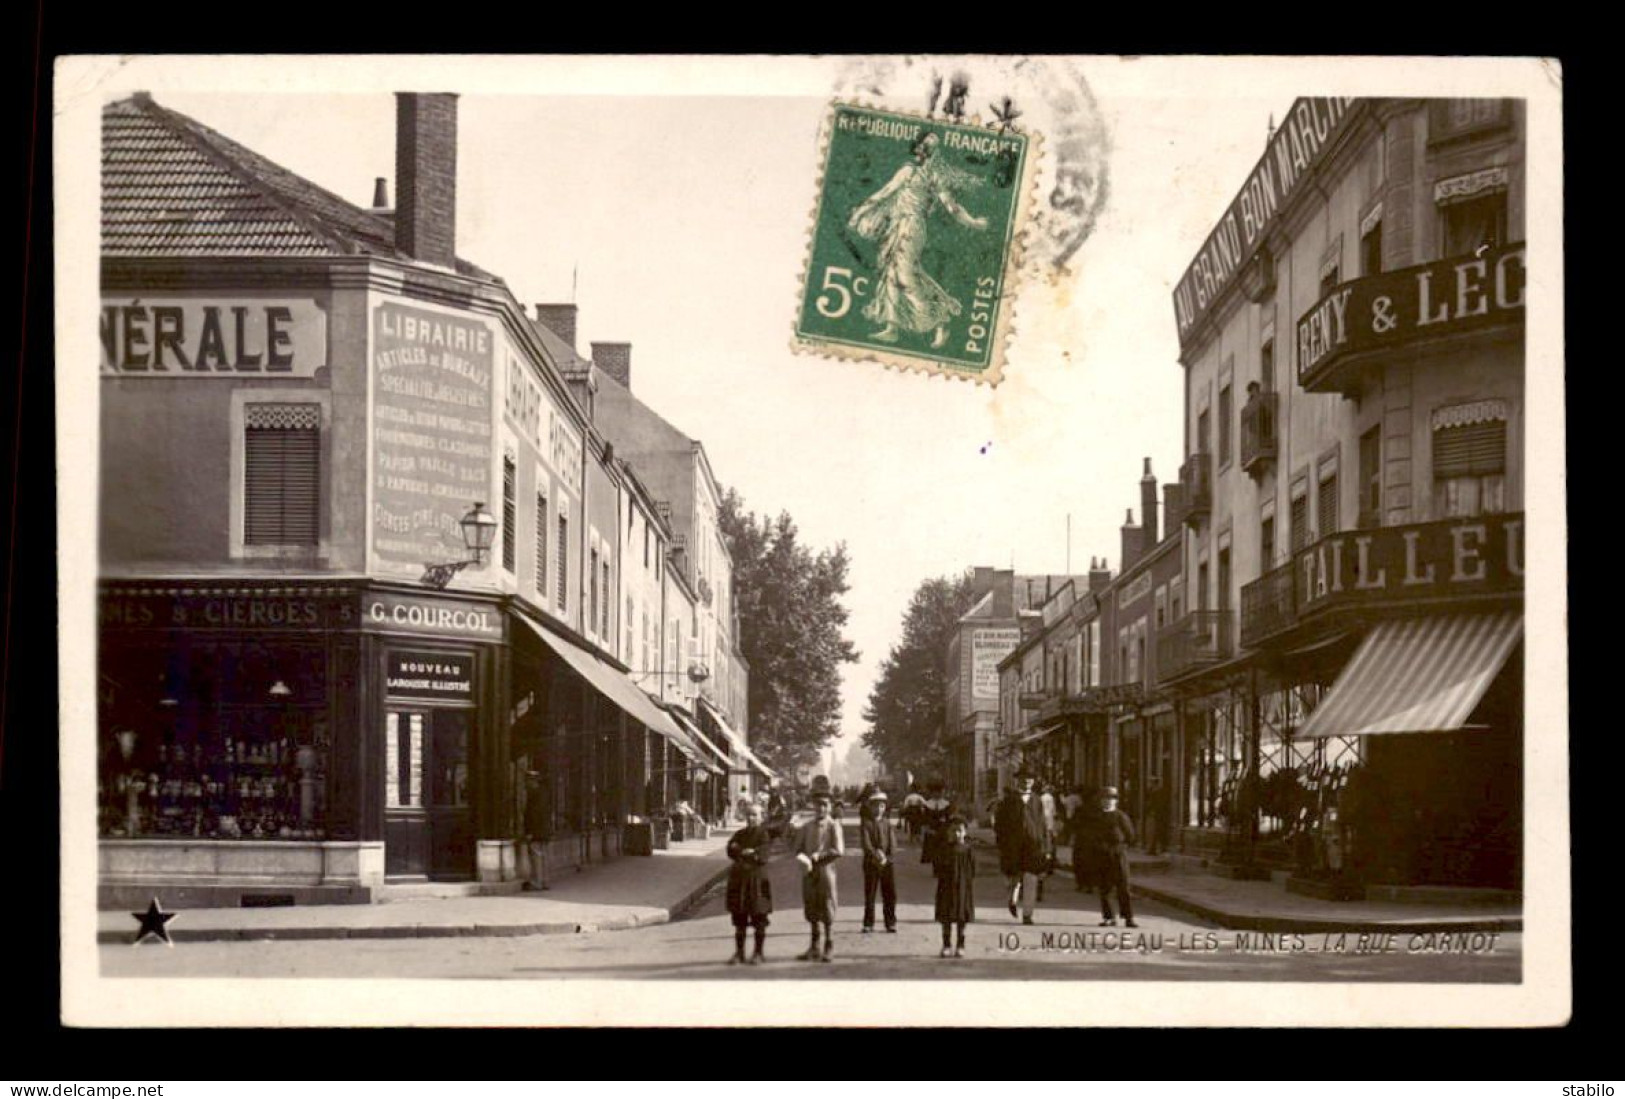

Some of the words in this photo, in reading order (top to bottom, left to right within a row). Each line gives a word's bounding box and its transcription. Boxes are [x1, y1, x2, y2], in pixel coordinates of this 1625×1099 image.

[1176, 282, 1194, 328] AU
[1192, 212, 1242, 309] GRAND
[1240, 158, 1277, 245] BON
[1275, 97, 1352, 196] MARCH
[382, 311, 488, 354] LIBRAIRIE
[966, 276, 996, 354] POSTES
[1372, 296, 1397, 333] &
[376, 347, 427, 372] ARTICLES
[442, 352, 490, 392] BUREAUX
[205, 601, 318, 625] CIERGES
[371, 602, 389, 623] G.
[393, 604, 494, 632] COURCOL
[401, 662, 460, 676] NOUVEAU
